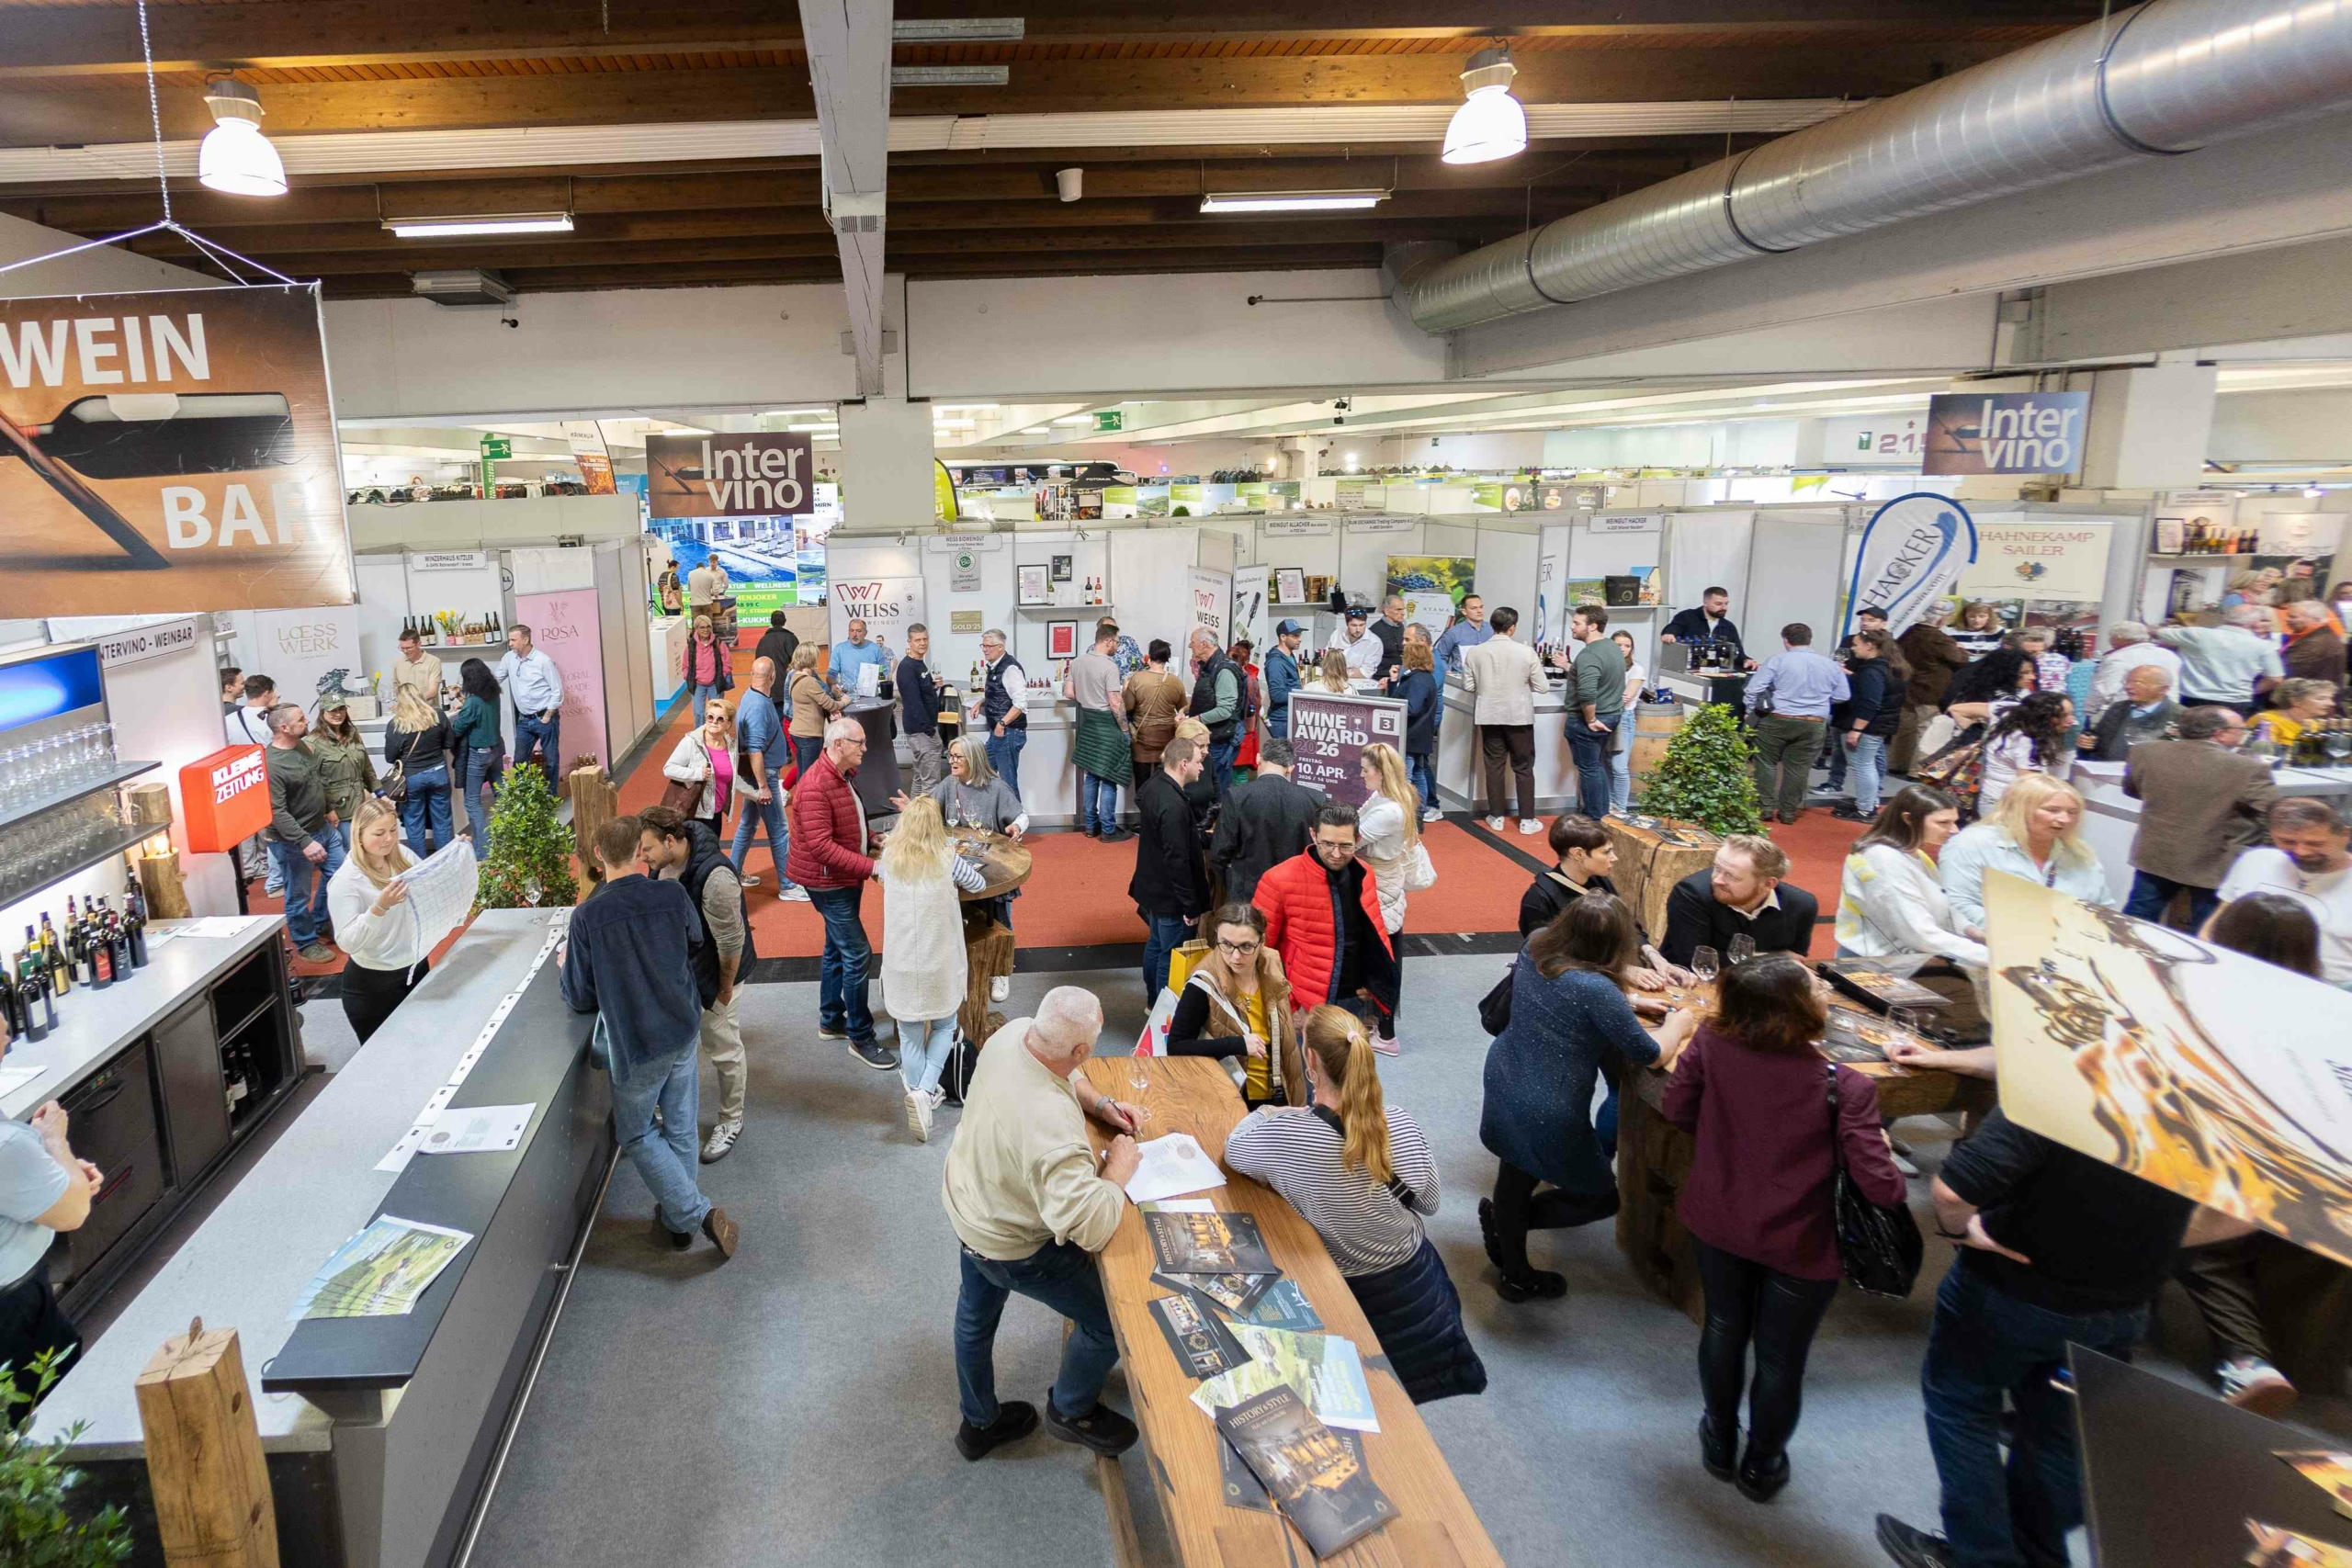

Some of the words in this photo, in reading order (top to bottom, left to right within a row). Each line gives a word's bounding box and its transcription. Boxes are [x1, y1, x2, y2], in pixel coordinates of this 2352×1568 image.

[0, 313, 210, 388] WEIN
[1979, 399, 2078, 439] Inter
[702, 440, 804, 479] Inter
[1980, 434, 2072, 468] vino
[706, 467, 803, 510] vino
[1979, 531, 2095, 543] HAHNEKAMP
[2003, 546, 2064, 556] SAILER
[1861, 528, 1941, 608] HACKER
[844, 603, 899, 618] WEISS
[1888, 571, 1948, 634] ackerwein.com
[1196, 610, 1220, 629] WEISS
[100, 636, 146, 660] NTERVINO
[154, 626, 194, 649] WEINBAR
[541, 625, 579, 641] ROSA
[278, 636, 339, 655] WERK
[1295, 700, 1367, 716] INTERVINO
[1295, 710, 1347, 729] WINE
[1382, 719, 1391, 728] 3
[1295, 725, 1369, 746] AWARD
[1295, 739, 1340, 757] 2026
[212, 750, 263, 787] KLEINE
[1296, 762, 1314, 774] 10.
[1316, 765, 1347, 779] APR.
[215, 767, 265, 805] ZEITUNG
[1229, 1405, 1264, 1428] HISTORY
[1266, 1392, 1291, 1410] STYLE
